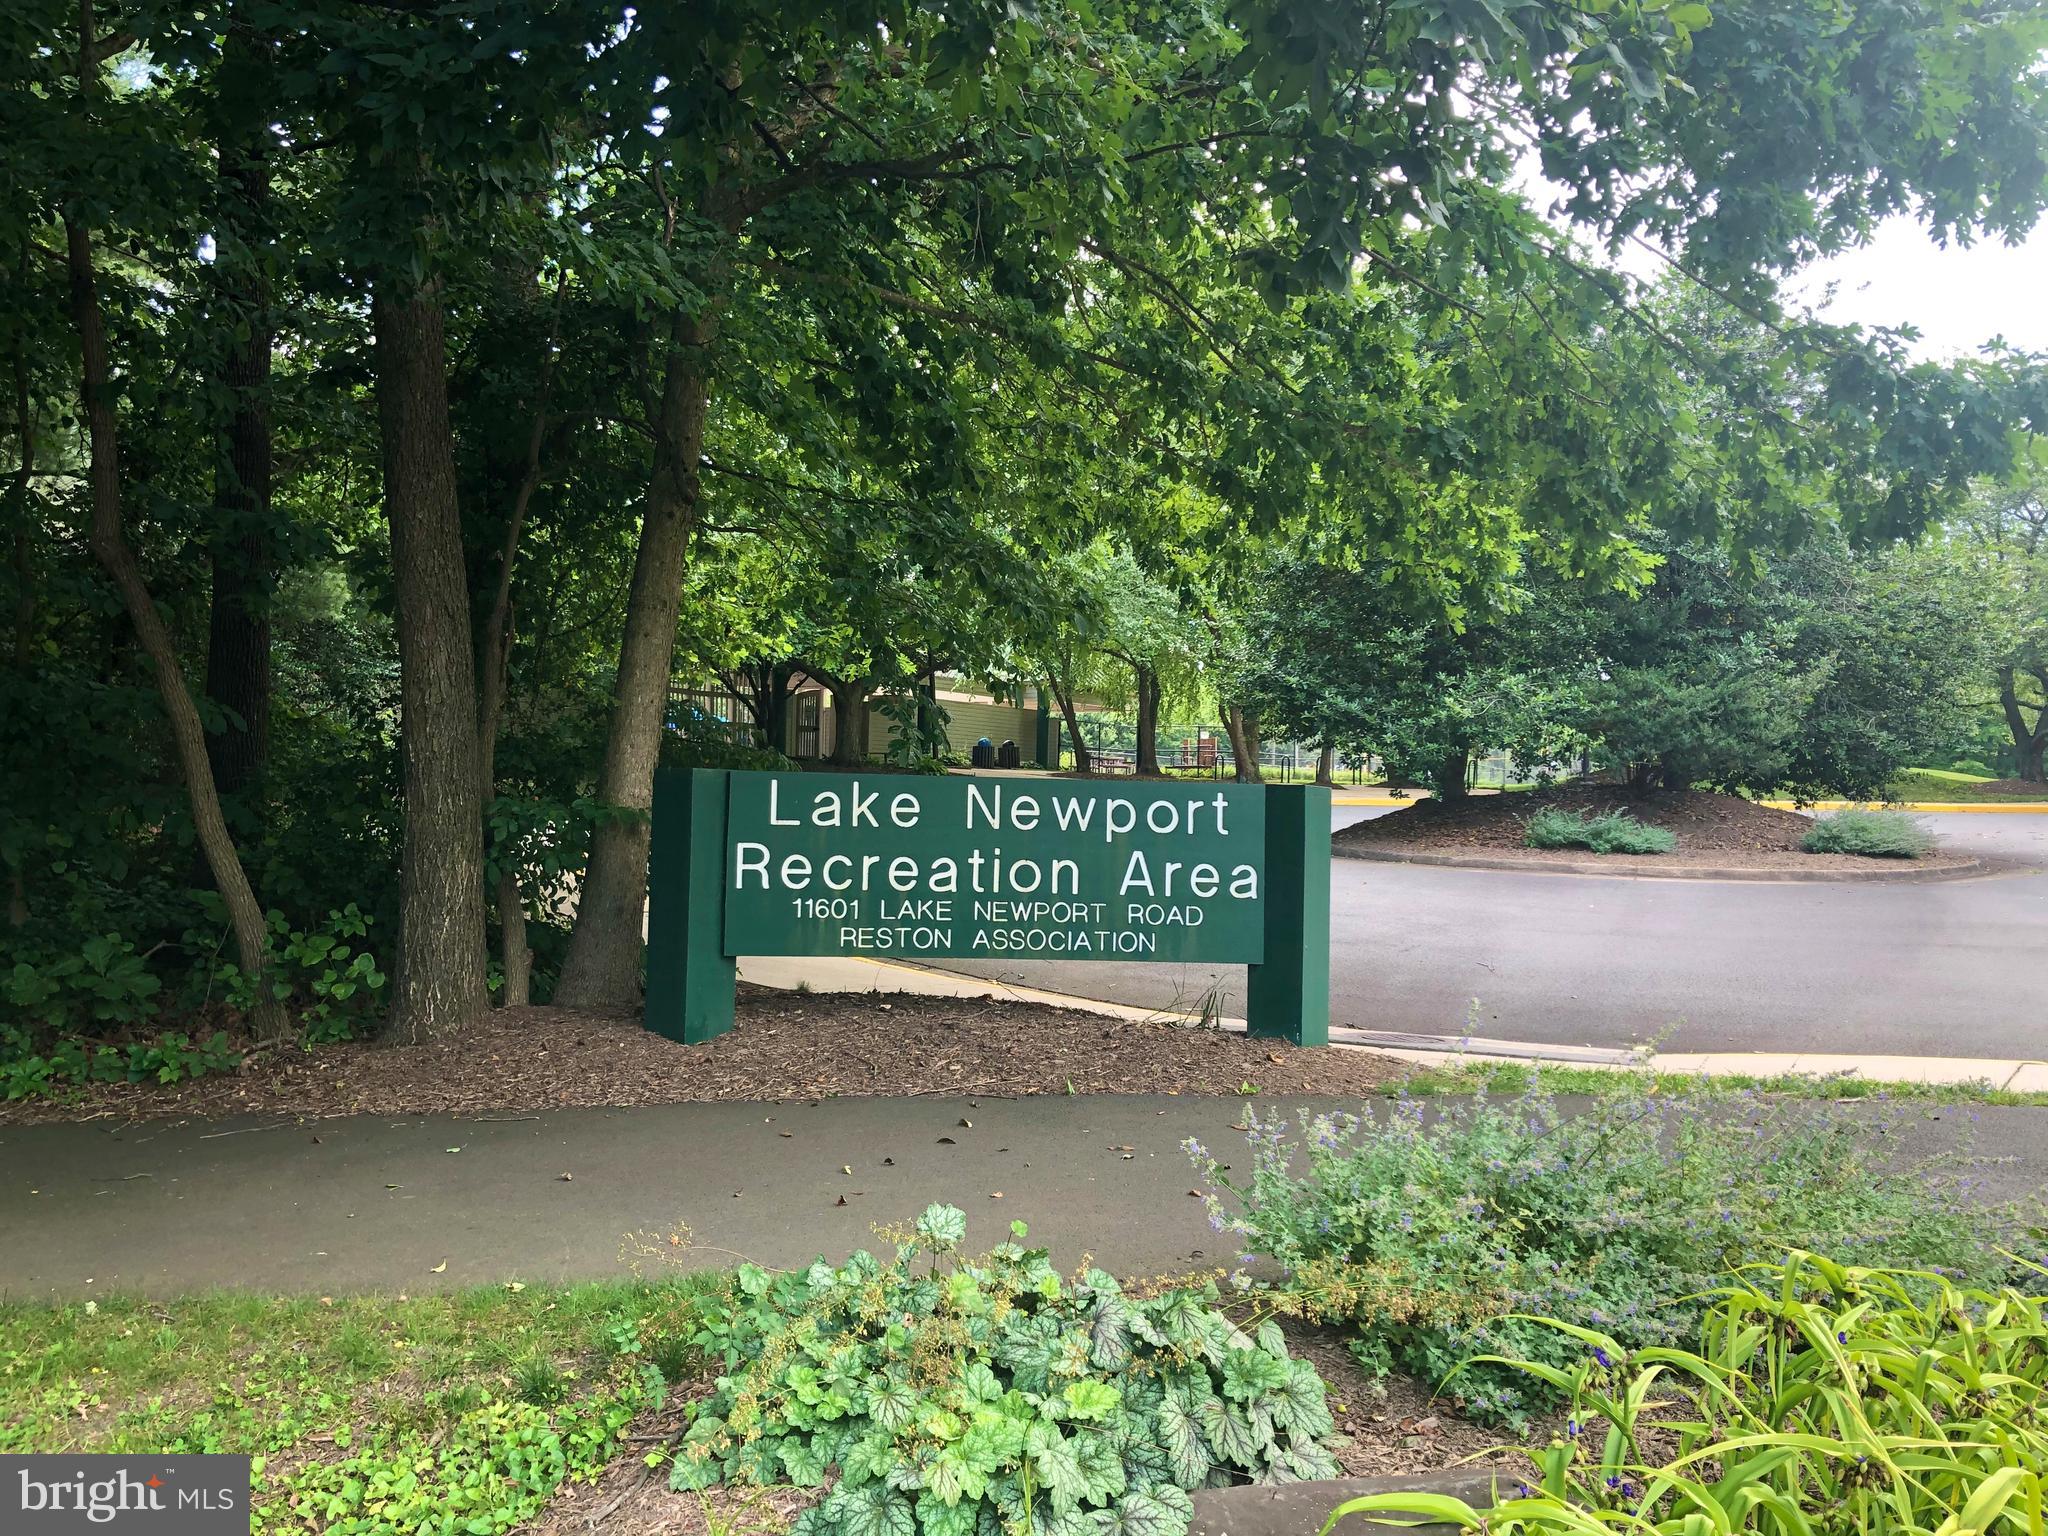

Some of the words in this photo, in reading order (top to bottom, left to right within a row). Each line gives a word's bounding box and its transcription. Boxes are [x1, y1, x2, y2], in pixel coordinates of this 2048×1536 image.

[770, 779, 922, 828] Lake
[966, 783, 1230, 843] Newport
[735, 842, 1079, 895] Recreation
[1119, 850, 1258, 900] Area
[792, 898, 860, 920] 11601
[880, 900, 953, 921] LAKE
[974, 901, 1107, 924] NEWPORT
[1127, 903, 1204, 926] ROAD
[840, 926, 952, 949] RESTON
[972, 928, 1156, 953] ASSOCIATION
